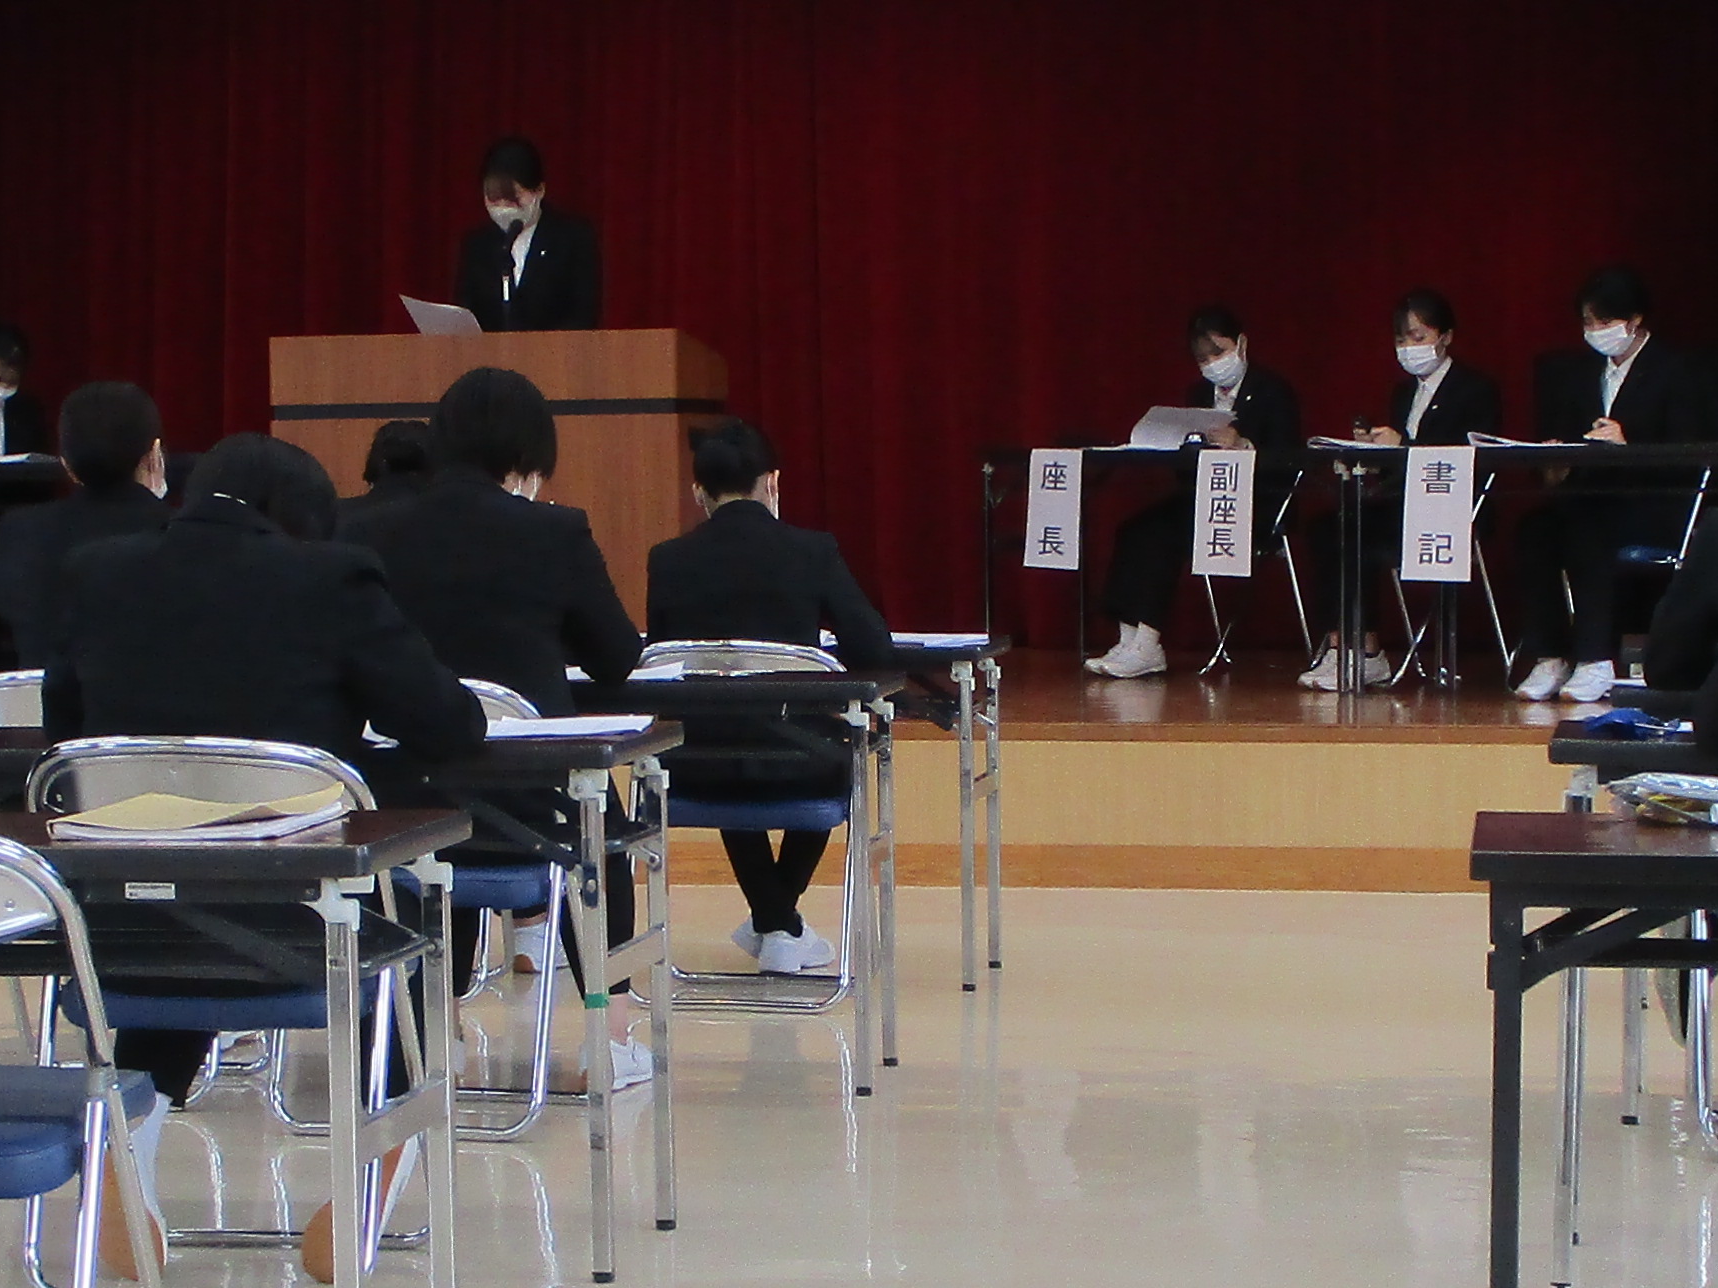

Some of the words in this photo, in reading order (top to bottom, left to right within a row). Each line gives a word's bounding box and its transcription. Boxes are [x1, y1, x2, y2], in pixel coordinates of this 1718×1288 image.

[1037, 460, 1068, 557] 座長
[1206, 461, 1239, 559] 副座長
[1417, 460, 1458, 566] 書記
